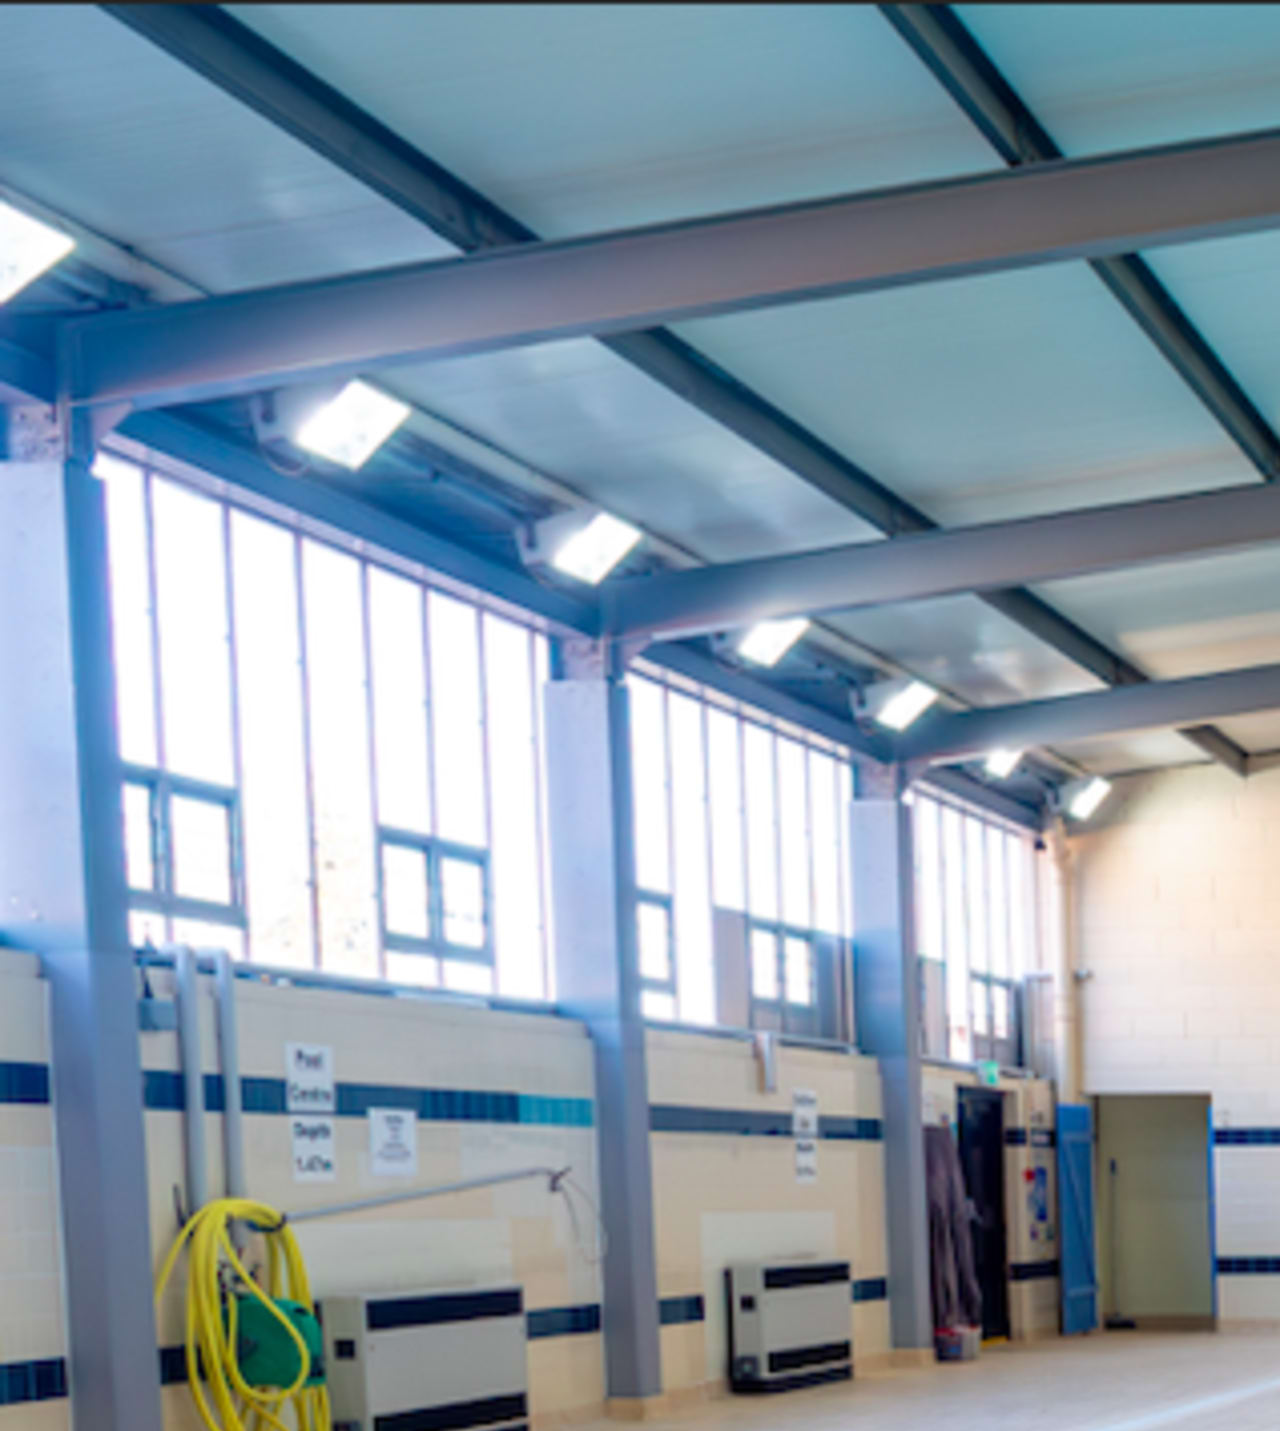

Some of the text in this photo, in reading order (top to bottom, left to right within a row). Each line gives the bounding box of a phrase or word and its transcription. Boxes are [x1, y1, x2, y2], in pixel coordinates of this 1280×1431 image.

[295, 1048, 323, 1069] Pool
[290, 1082, 332, 1103] Centre
[294, 1121, 332, 1142] Depth
